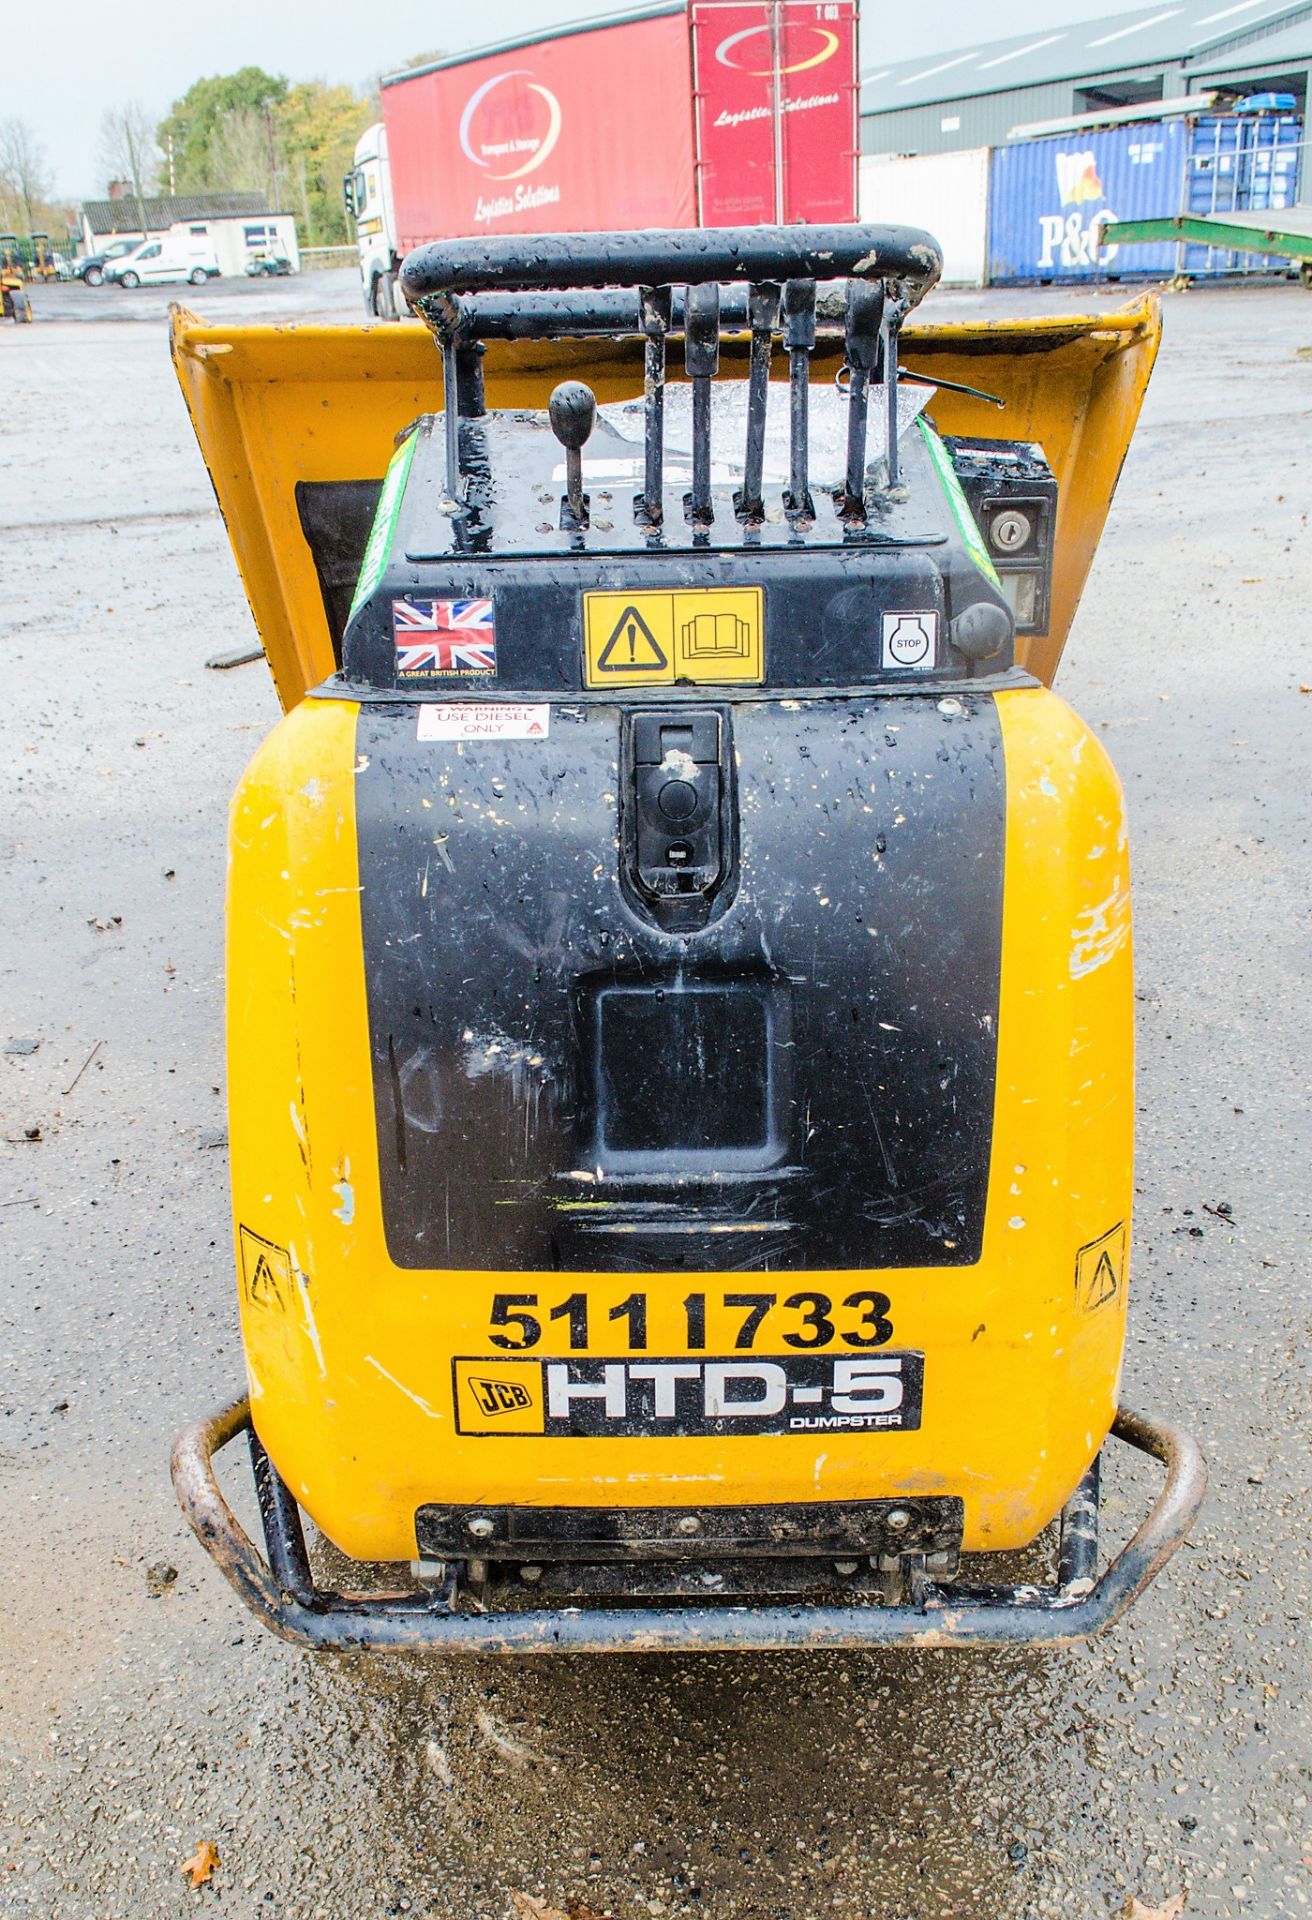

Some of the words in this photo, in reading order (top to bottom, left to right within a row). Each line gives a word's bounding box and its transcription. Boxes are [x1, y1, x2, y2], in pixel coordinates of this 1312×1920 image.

[474, 196, 513, 227] Logistics
[514, 183, 560, 212] Solutions
[896, 639, 922, 648] STOP
[399, 670, 406, 678] A
[406, 670, 429, 678] GREAT
[431, 669, 459, 677] BRITISH
[437, 713, 469, 722] USE
[475, 712, 532, 721] DIESEL
[463, 724, 504, 734] ONLY
[487, 1291, 894, 1350] 5111733
[547, 1358, 904, 1418] HTD-5
[480, 1382, 528, 1412] JCB
[789, 1414, 902, 1429] DUMPSTER
